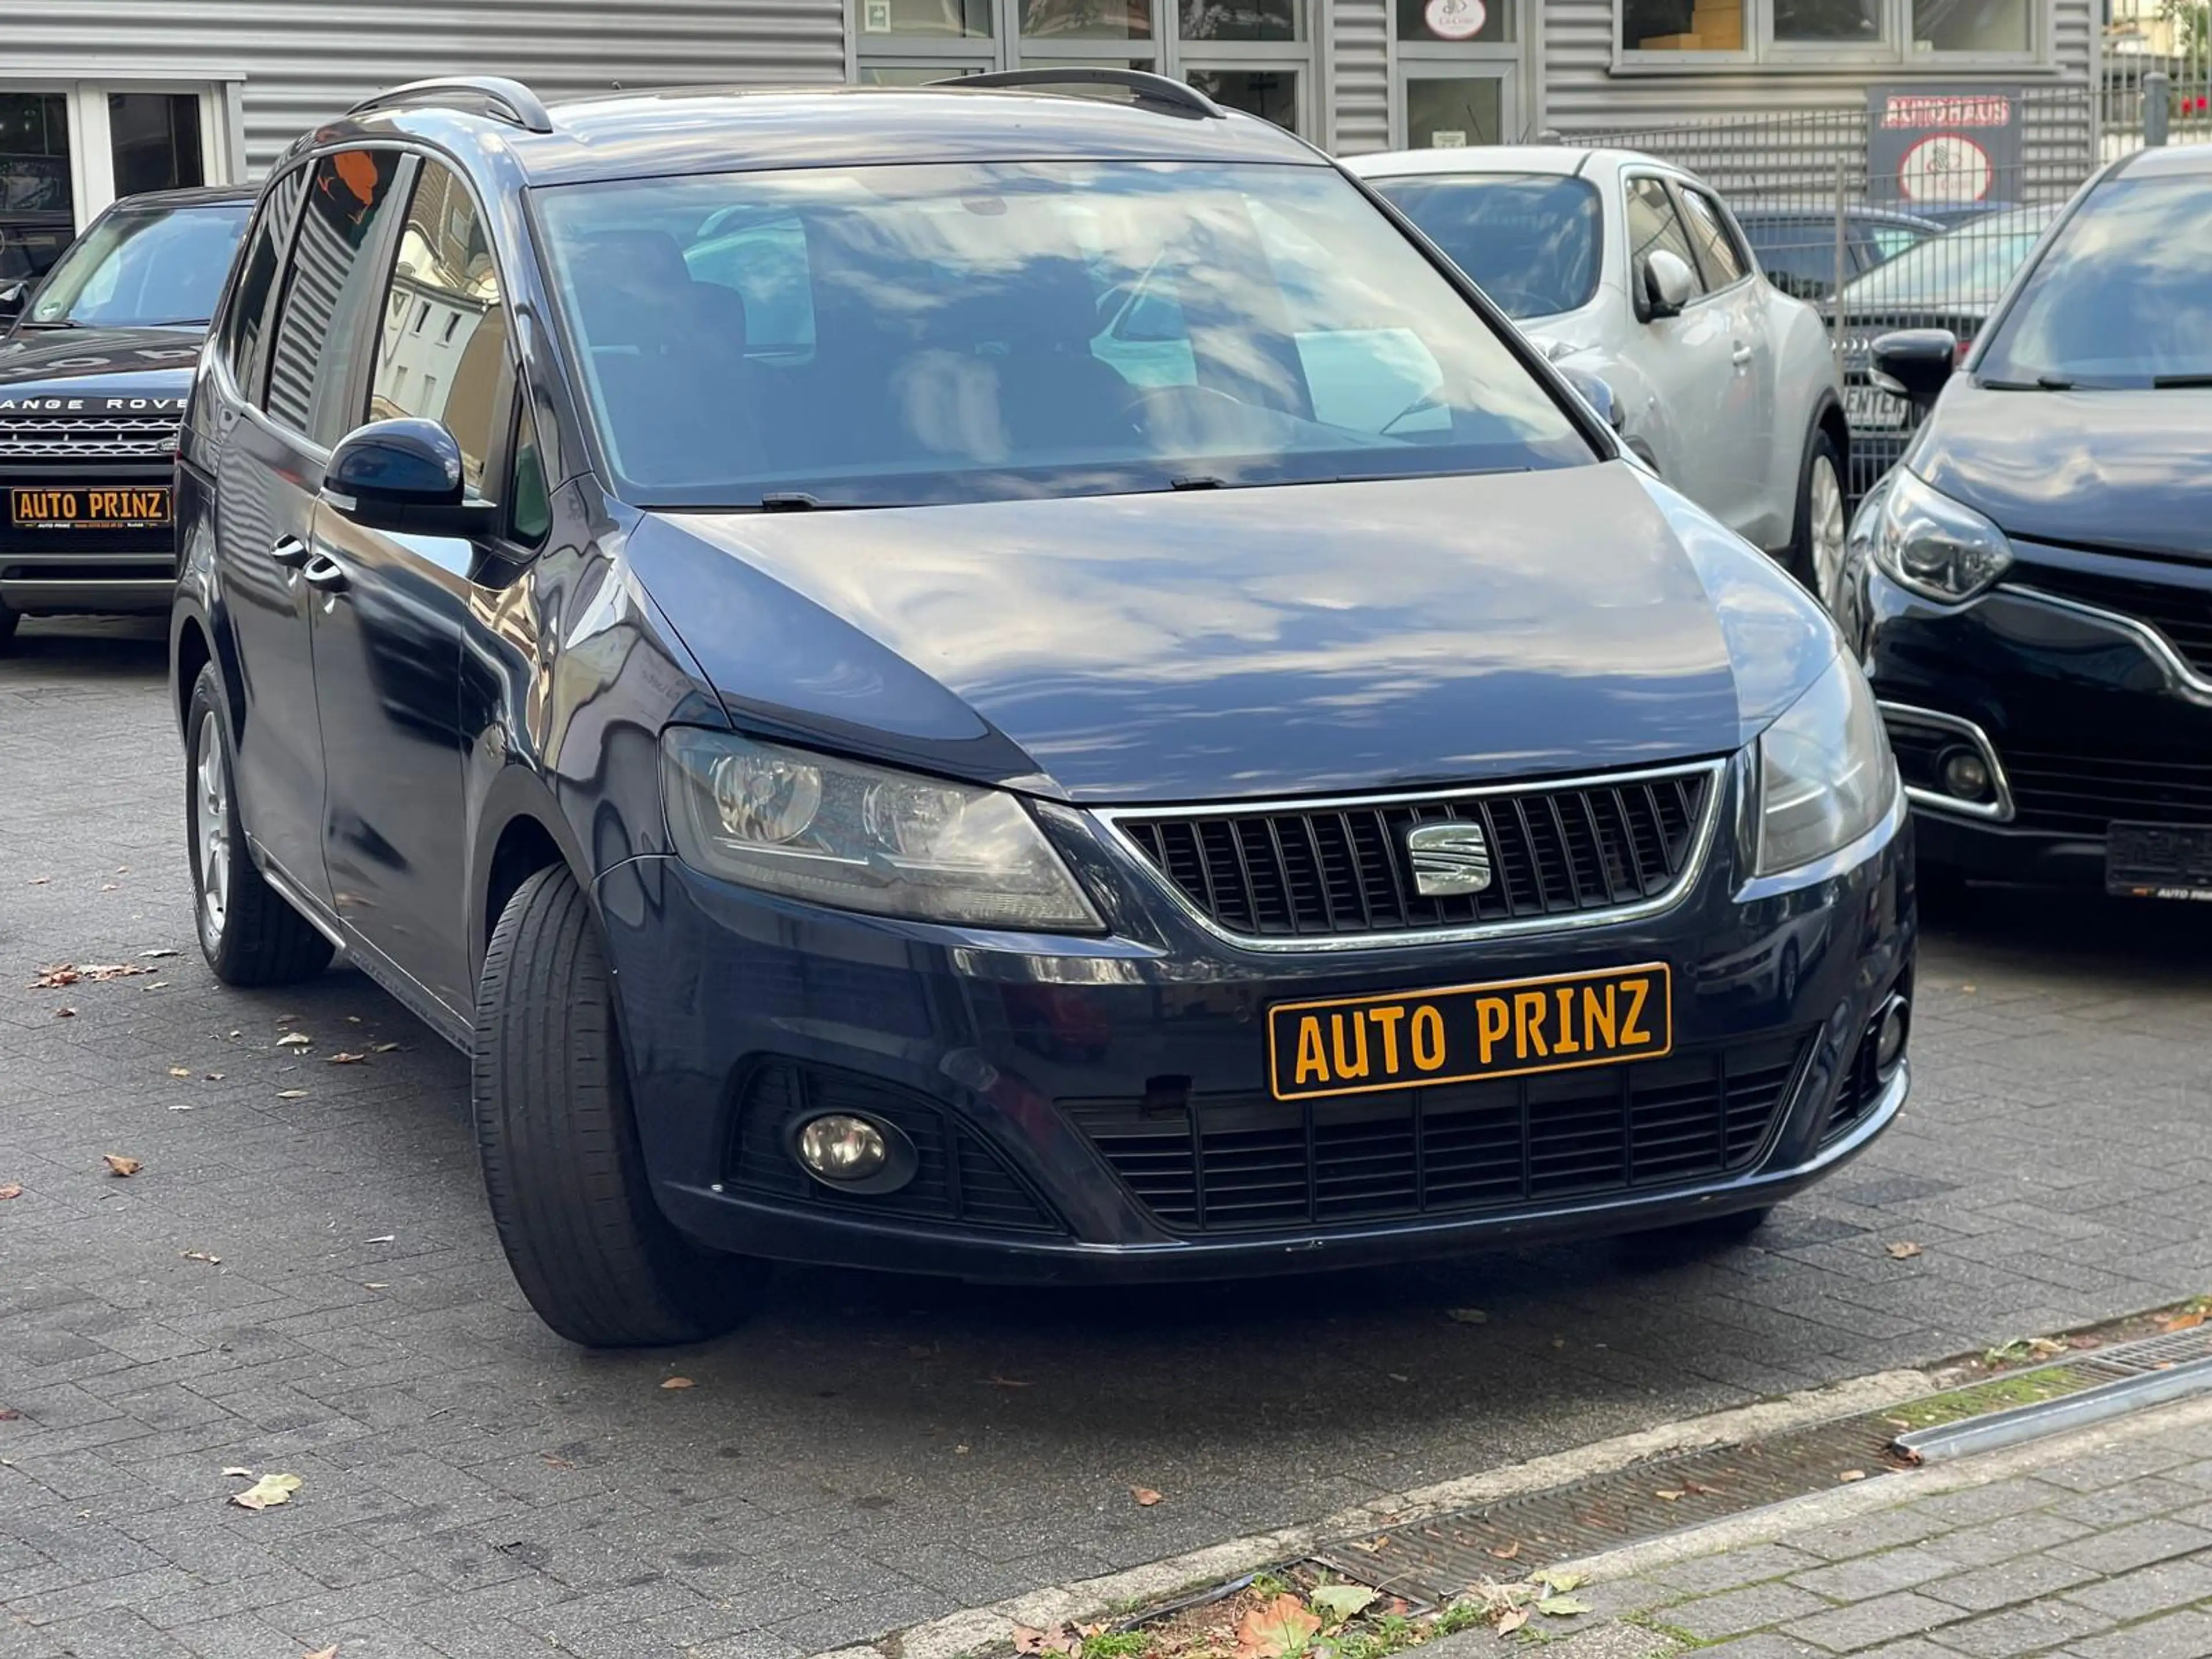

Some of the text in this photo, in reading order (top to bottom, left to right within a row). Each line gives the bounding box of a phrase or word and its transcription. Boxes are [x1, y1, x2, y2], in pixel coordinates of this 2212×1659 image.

[1883, 96, 2010, 128] AUTOHAUS
[0, 399, 188, 410] ANGE ROVE
[20, 493, 163, 518] AUTO PRINZ
[1296, 979, 1650, 1084] AUTO PRINZ
